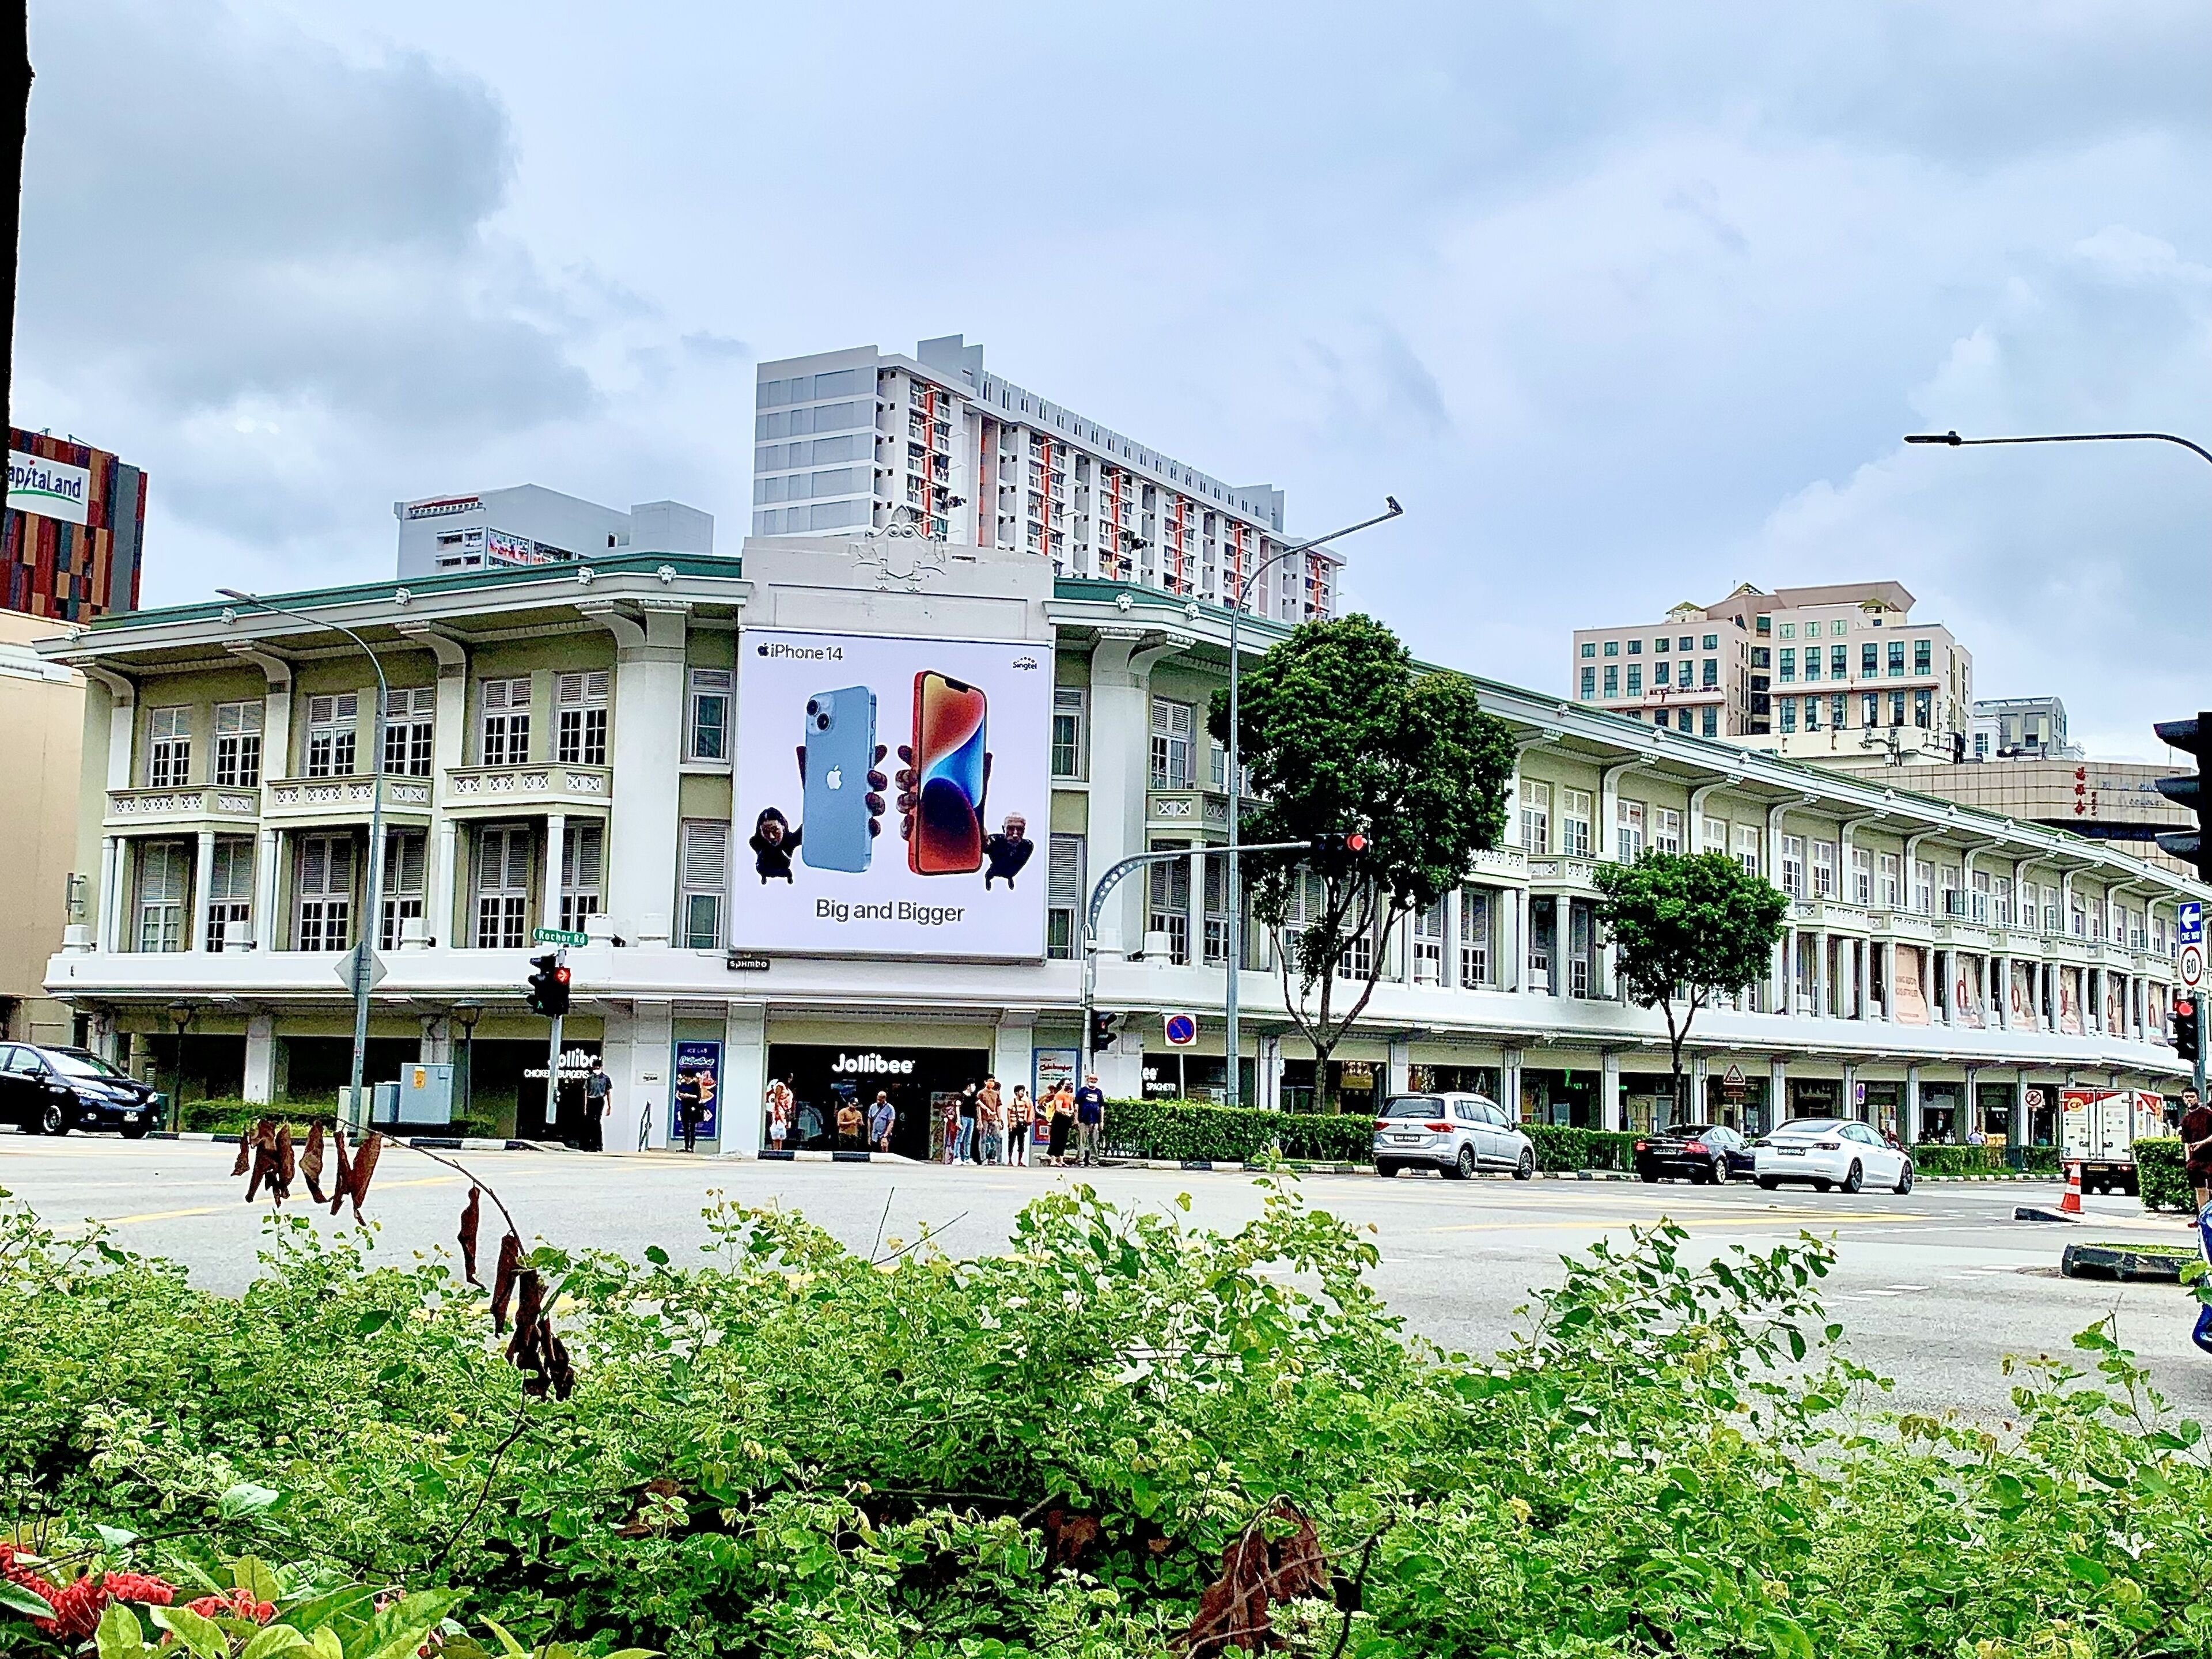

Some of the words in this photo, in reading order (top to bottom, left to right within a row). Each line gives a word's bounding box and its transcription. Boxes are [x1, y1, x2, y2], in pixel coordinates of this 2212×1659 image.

[8, 460, 82, 498] apitaLand
[771, 643, 824, 660] iPhone
[826, 646, 843, 661] 14
[1013, 661, 1037, 671] Singtel
[816, 899, 849, 922] Big
[853, 901, 892, 919] and
[898, 902, 965, 926] Bigger
[539, 930, 571, 942] Rochor
[574, 934, 585, 944] Rd
[2187, 958, 2196, 974] 60
[548, 1048, 601, 1068] ollib
[831, 1052, 916, 1074] Jollibee
[524, 1069, 551, 1078] CHICKE
